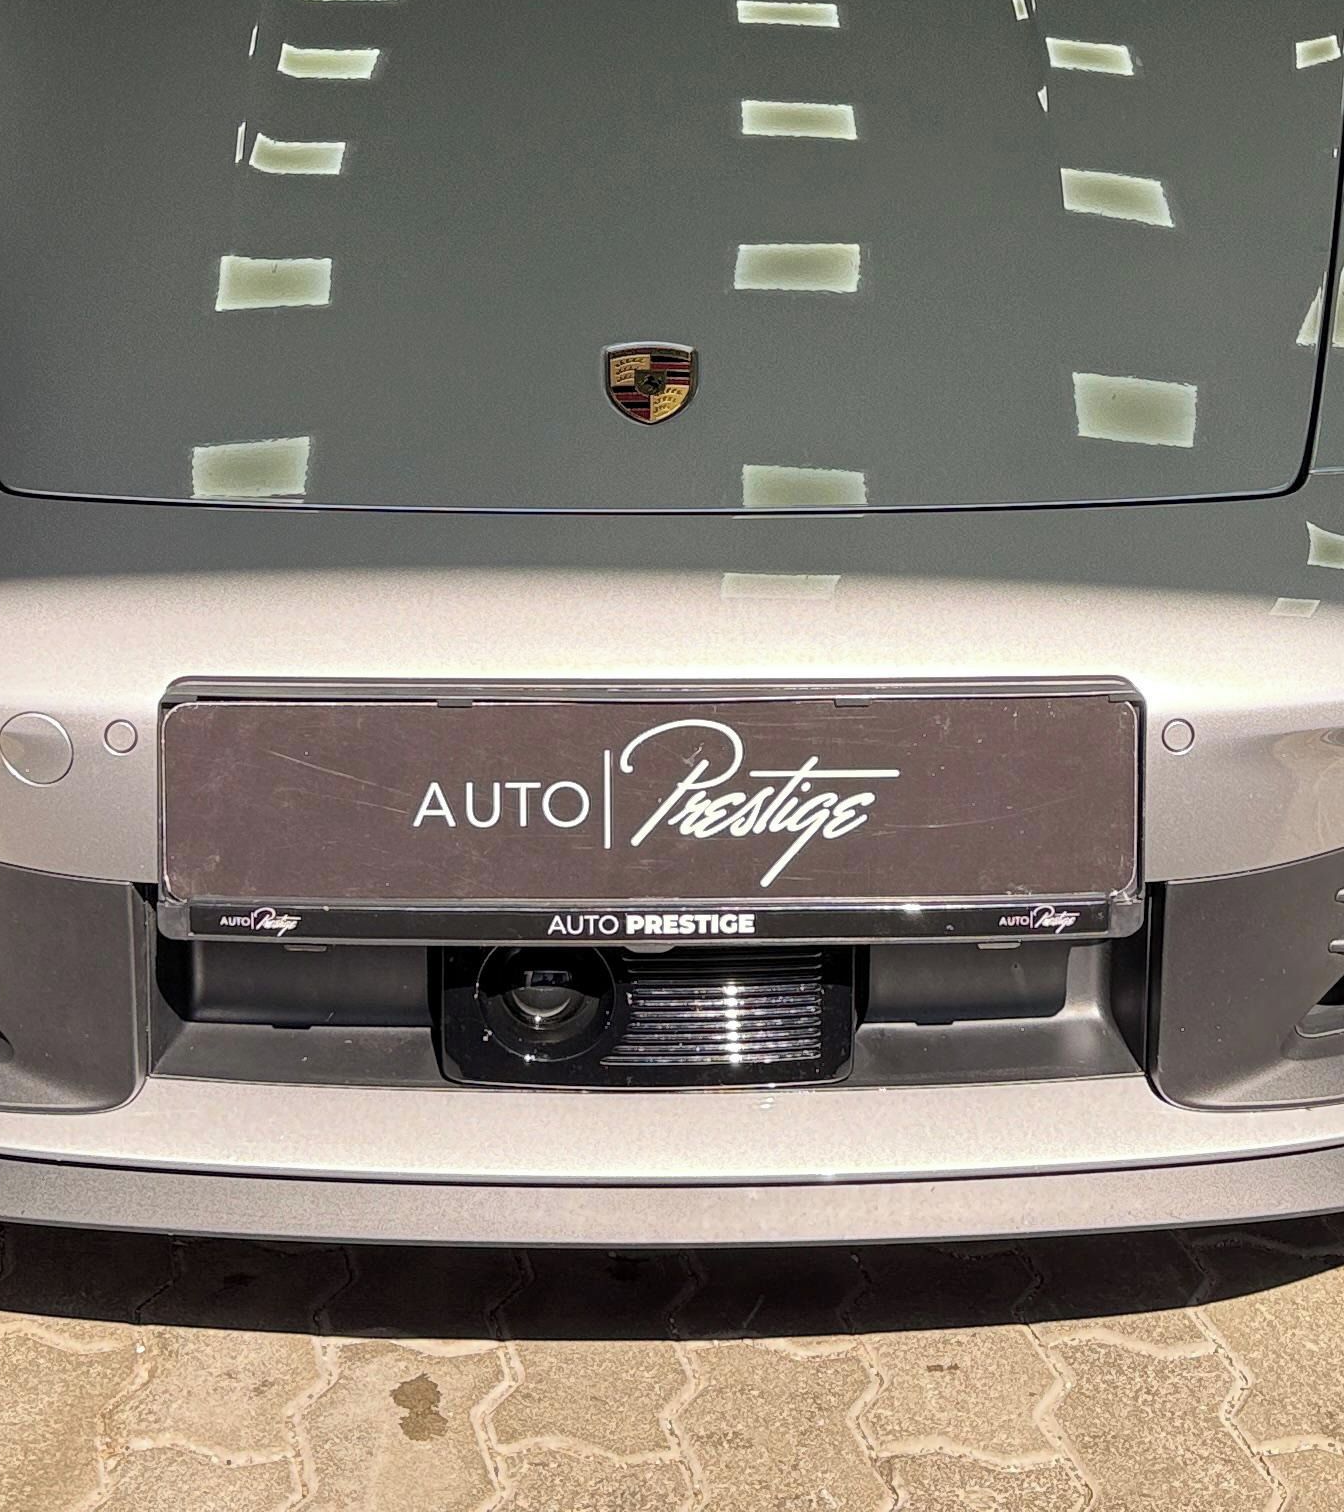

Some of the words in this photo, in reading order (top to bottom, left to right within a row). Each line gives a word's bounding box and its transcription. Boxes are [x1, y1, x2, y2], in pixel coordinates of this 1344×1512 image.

[412, 780, 592, 829] AUTO
[619, 718, 901, 888] Prestige
[219, 915, 251, 927] AUTO
[547, 914, 620, 935] AUTO
[625, 913, 756, 935] PRESTIGE
[998, 915, 1030, 927] AUTO
